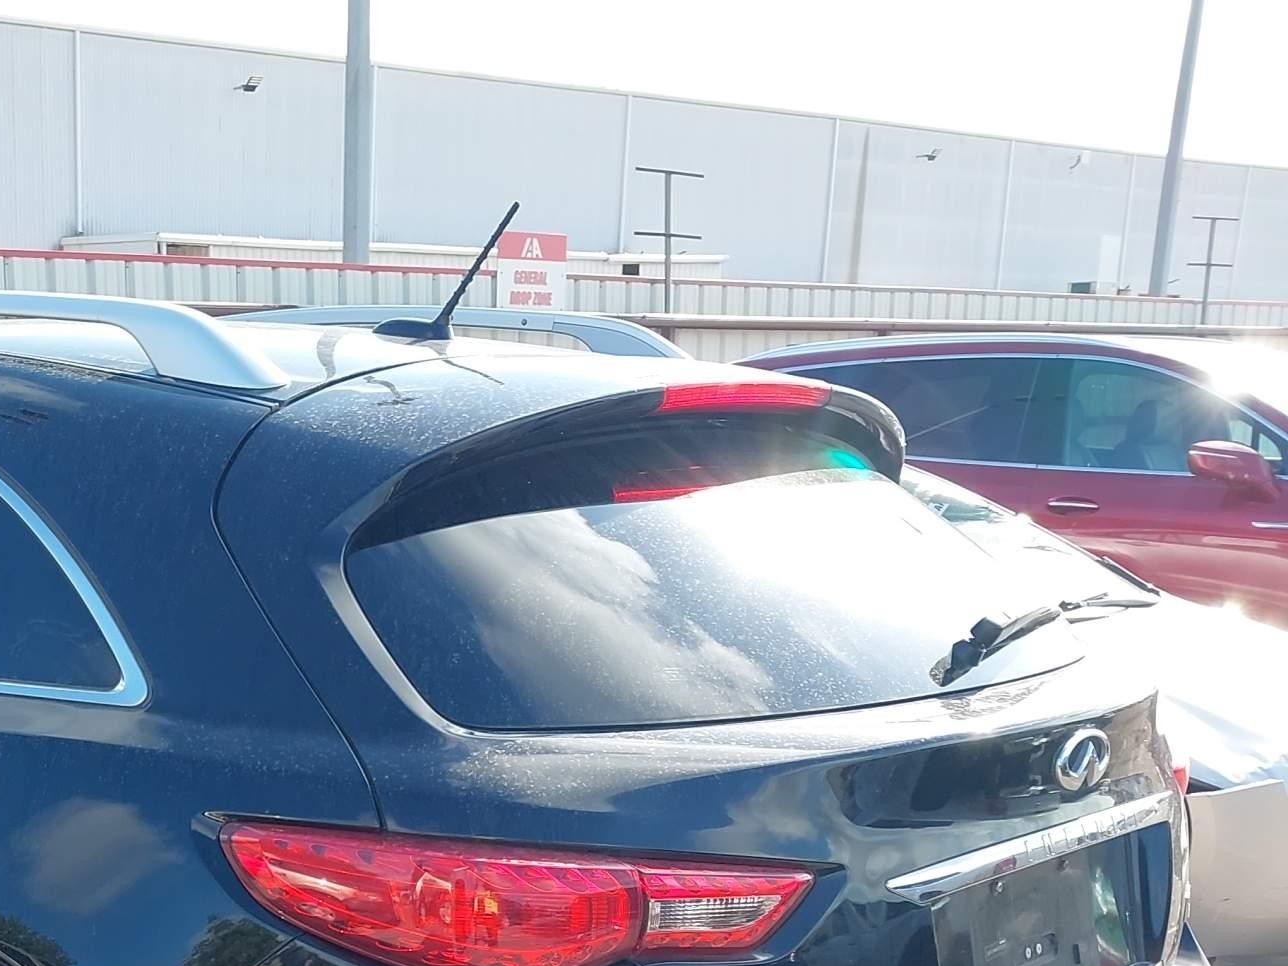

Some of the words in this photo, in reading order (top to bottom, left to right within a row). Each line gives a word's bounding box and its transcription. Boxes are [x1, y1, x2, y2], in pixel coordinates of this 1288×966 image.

[513, 270, 548, 286] GENERAL
[509, 290, 532, 305] DROP
[532, 291, 553, 306] ZONE
